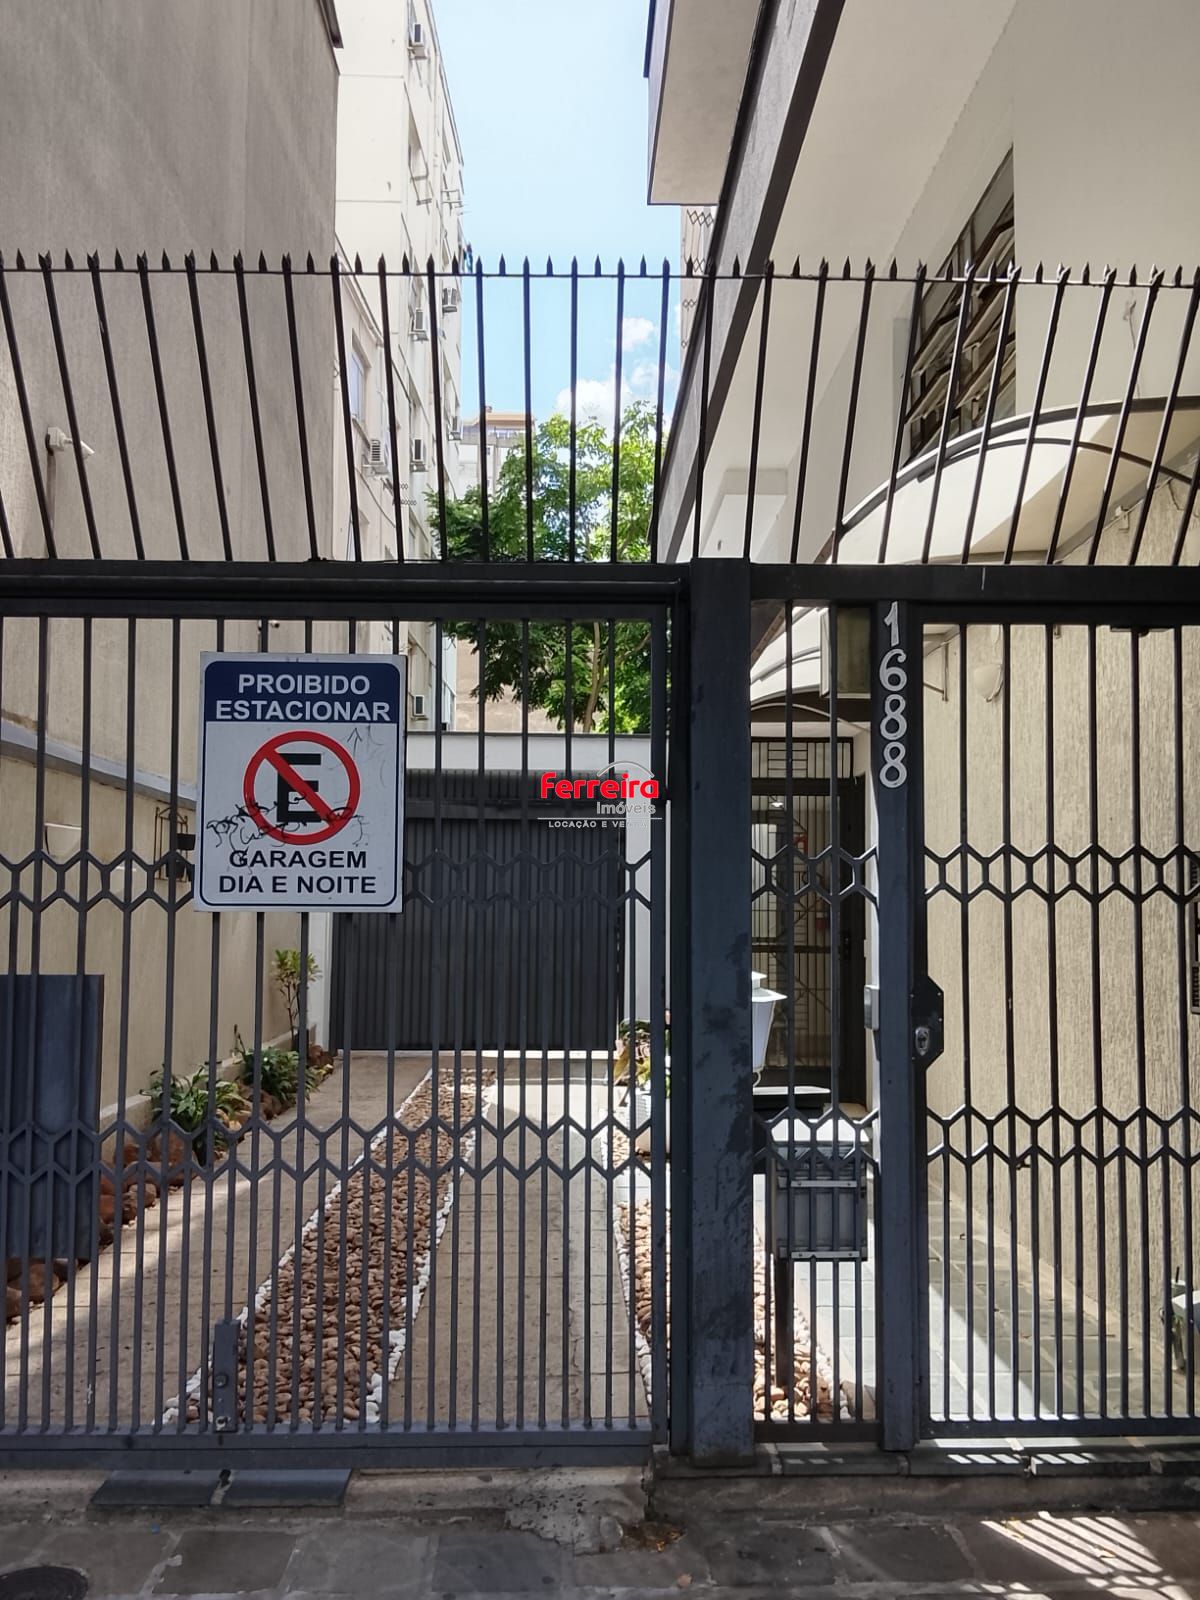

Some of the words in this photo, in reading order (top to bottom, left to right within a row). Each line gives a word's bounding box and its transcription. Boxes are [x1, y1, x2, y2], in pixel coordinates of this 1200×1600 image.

[238, 673, 370, 695] PROIBIDO
[879, 601, 907, 788] 1688
[215, 700, 391, 721] ESTACIONAR
[229, 850, 367, 868] GARAGEM
[219, 875, 264, 893] DIA
[272, 876, 287, 893] E
[297, 876, 376, 894] NOITE
